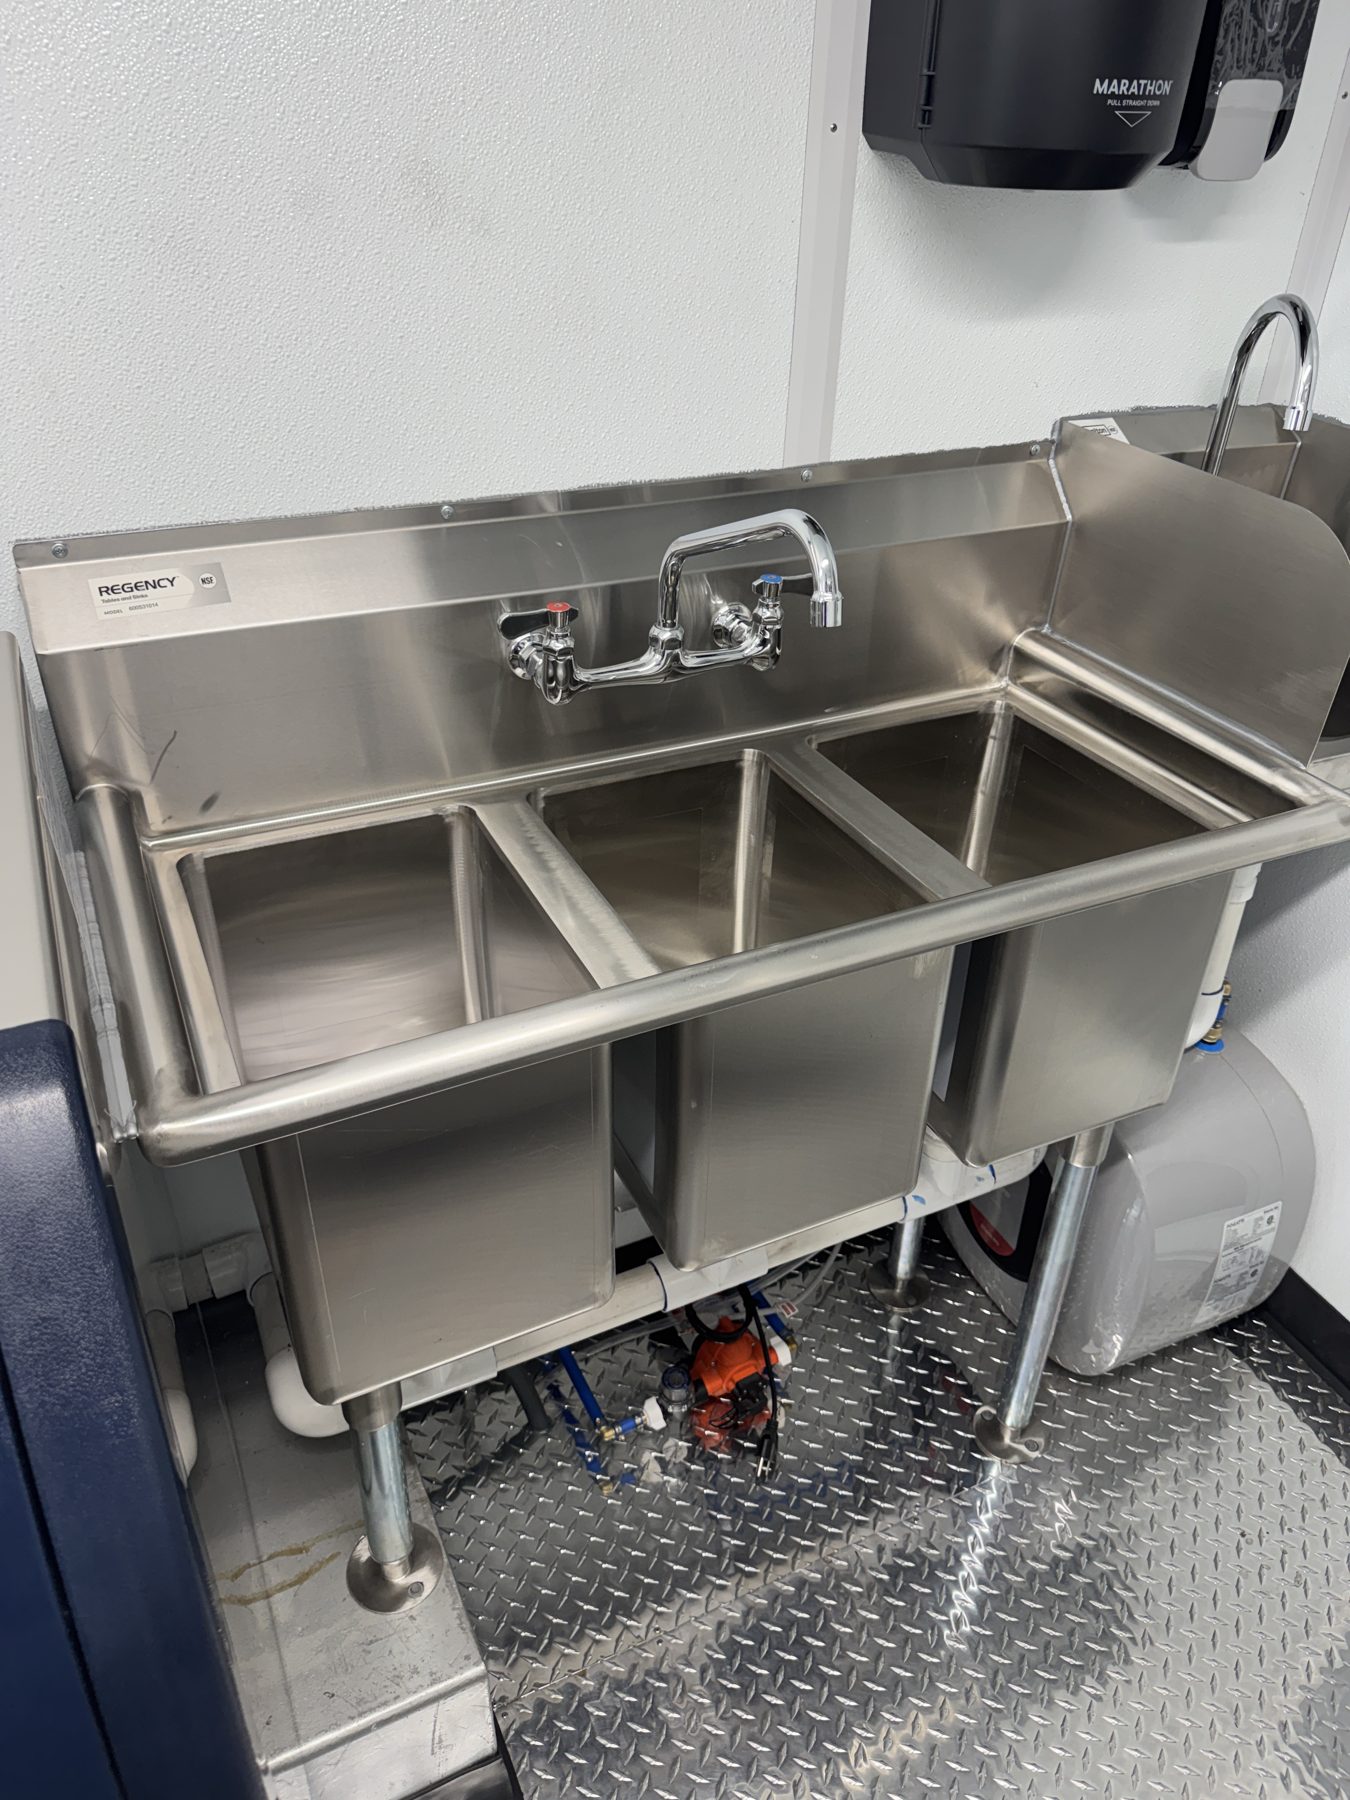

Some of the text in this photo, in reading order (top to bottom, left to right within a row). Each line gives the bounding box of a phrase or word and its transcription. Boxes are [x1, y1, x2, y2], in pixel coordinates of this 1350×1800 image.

[1093, 77, 1173, 96] MARATHON
[1122, 99, 1147, 107] STRAIGHT
[98, 576, 177, 597] REGENCY
[200, 576, 214, 585] NSF
